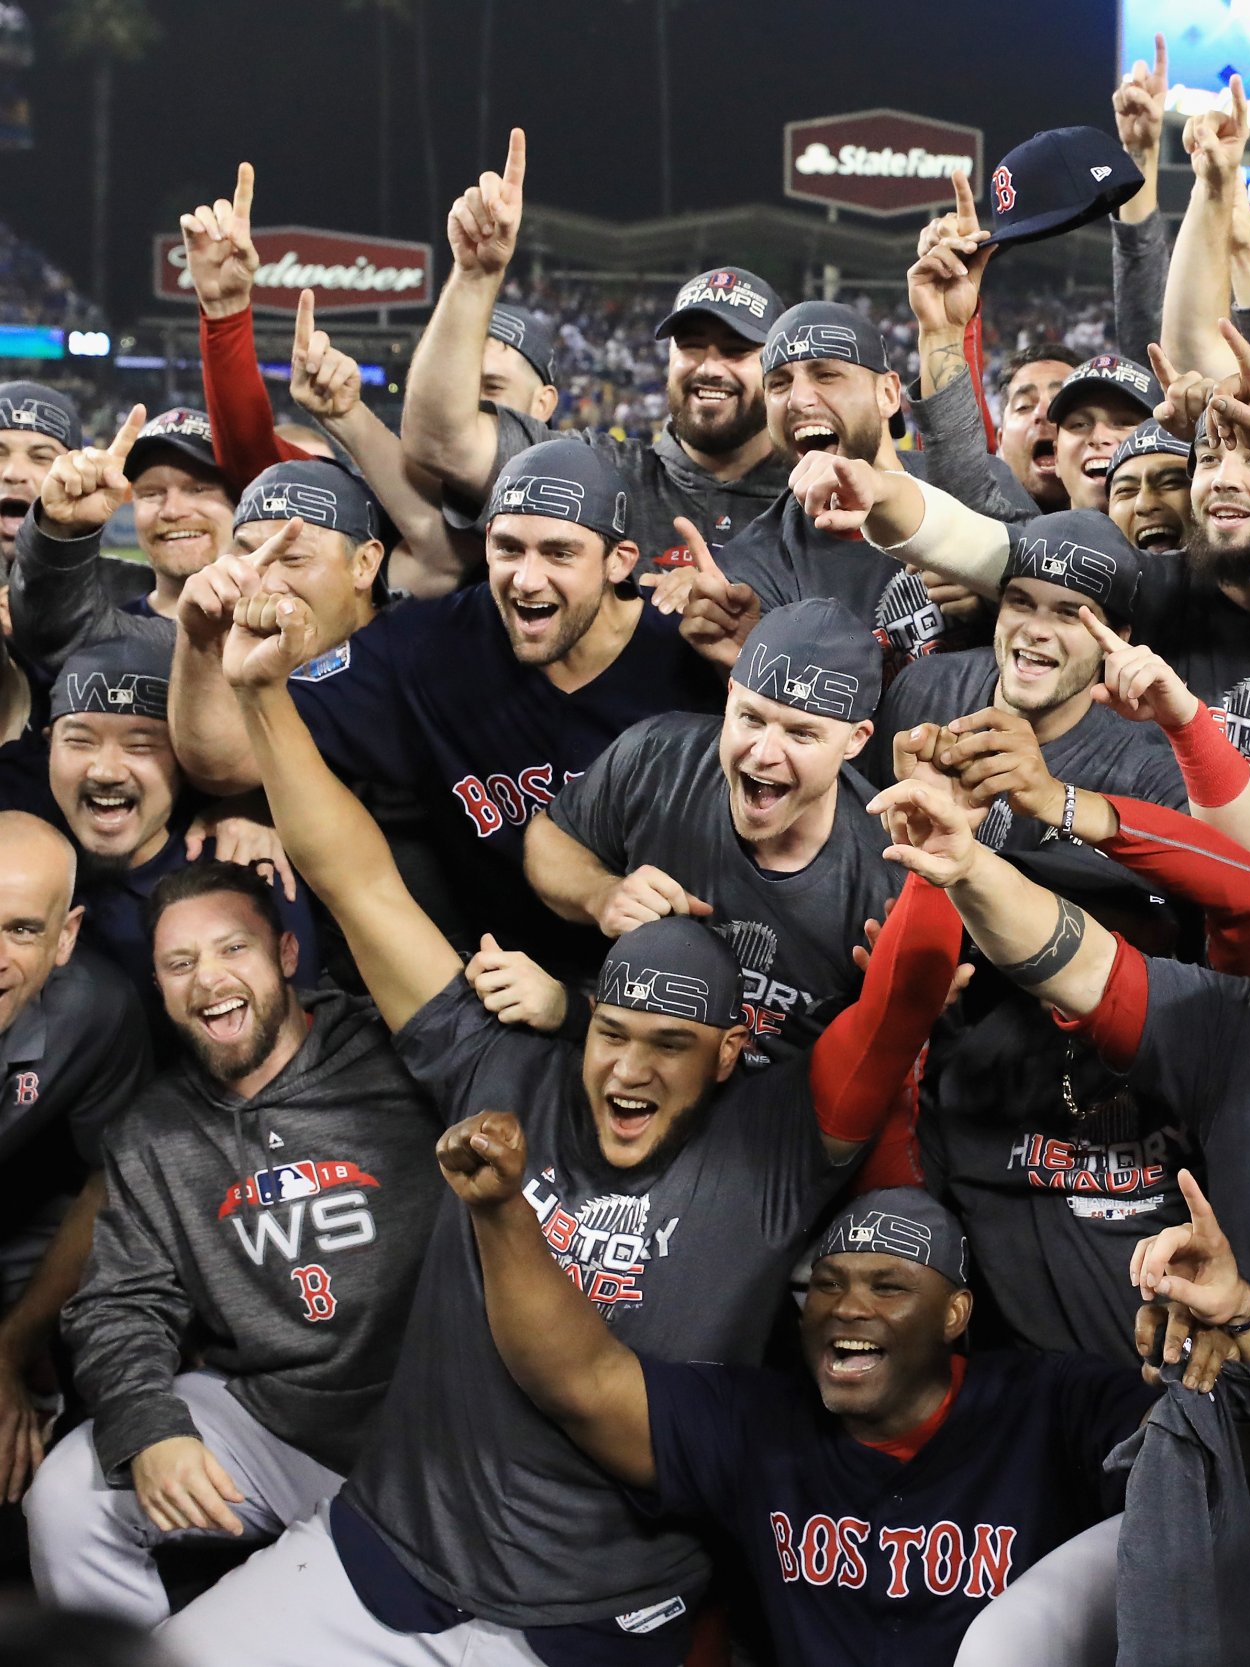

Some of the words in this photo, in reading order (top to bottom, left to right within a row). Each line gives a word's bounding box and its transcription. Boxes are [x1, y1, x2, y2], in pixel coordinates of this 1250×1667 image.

[992, 165, 1016, 214] B
[167, 245, 424, 291] dweiser
[1012, 537, 1117, 605] WS
[747, 643, 859, 721] WS
[1062, 811, 1074, 832] Love
[13, 1071, 39, 1105] B
[320, 1164, 348, 1180] 18
[231, 1190, 377, 1267] WS
[291, 1263, 338, 1322] B
[769, 1511, 1018, 1600] BOSTON
